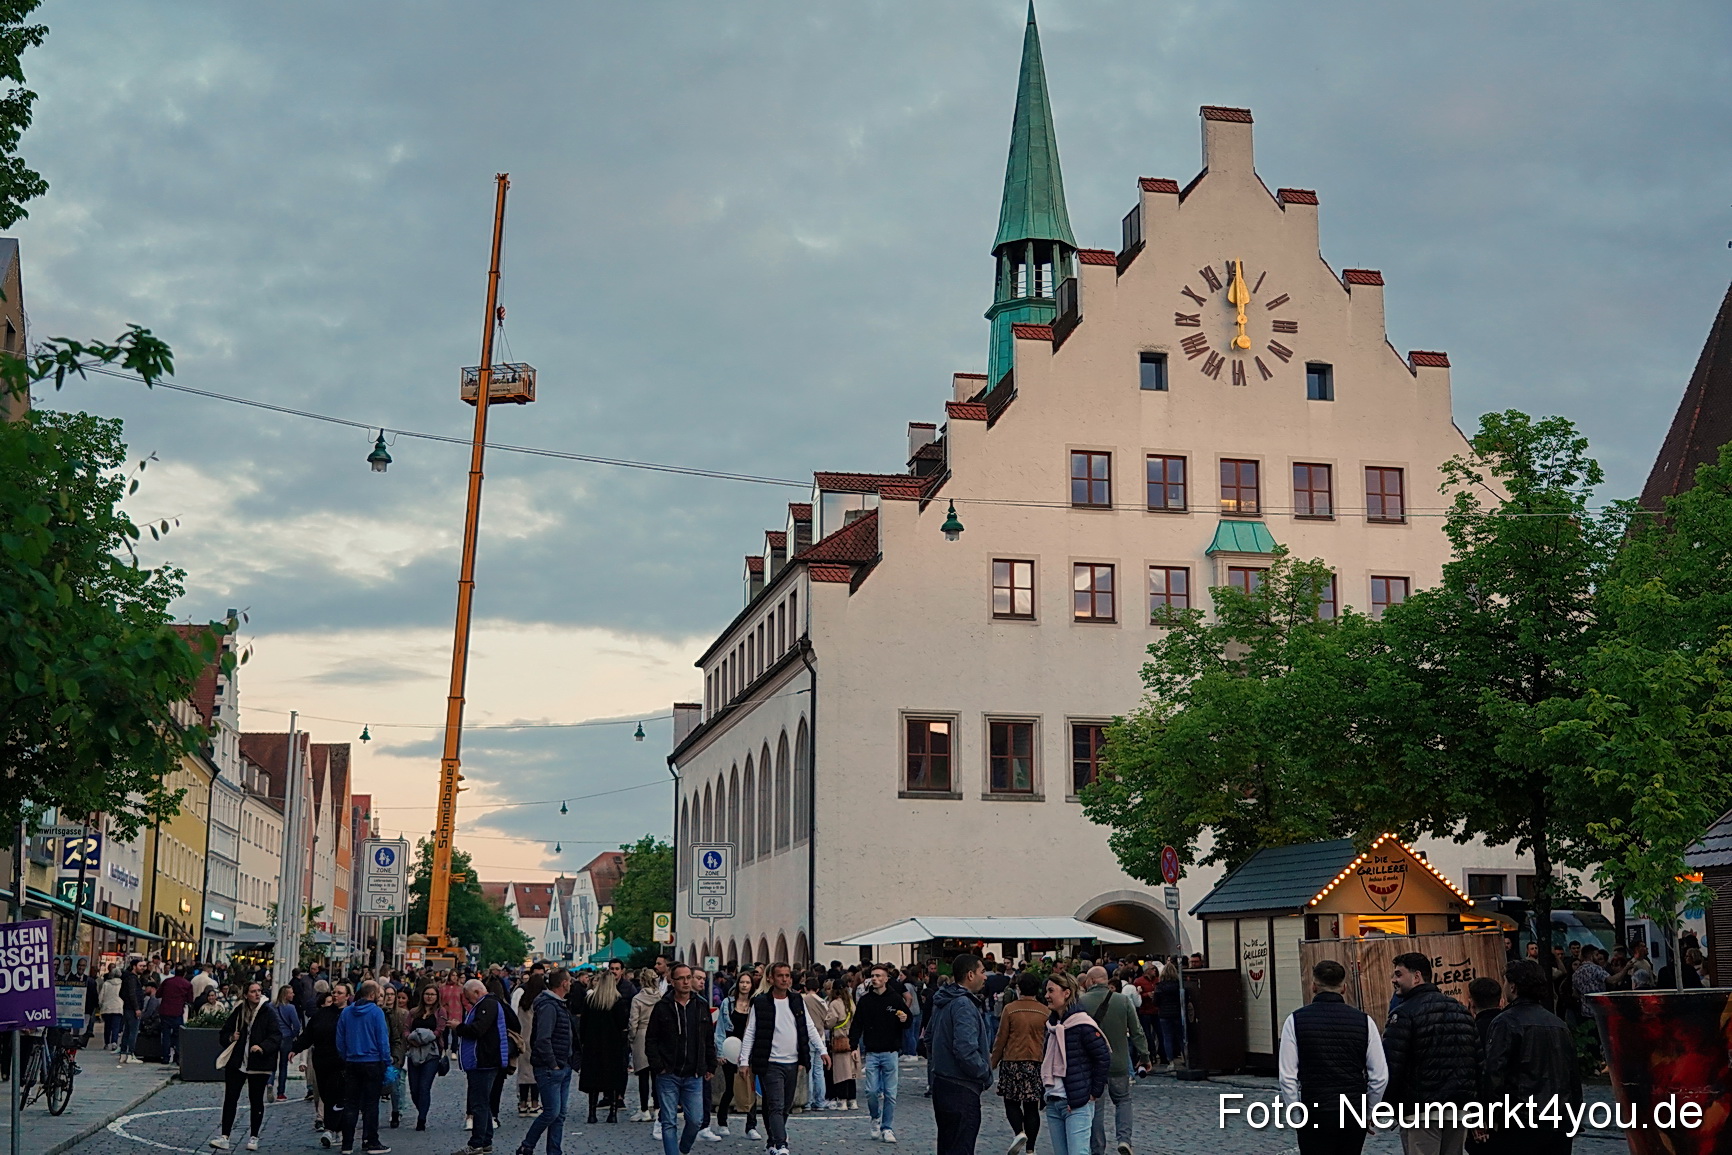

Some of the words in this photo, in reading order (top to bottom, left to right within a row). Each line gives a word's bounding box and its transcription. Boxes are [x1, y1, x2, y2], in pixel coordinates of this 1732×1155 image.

[438, 763, 454, 848] Schmidbauer
[39, 827, 82, 837] nwirtsgasse
[1357, 864, 1409, 876] GRILLEREI
[8, 926, 48, 946] KEIN
[0, 944, 48, 967] RSCH
[1430, 956, 1442, 968] IE
[0, 964, 50, 993] OCH
[1434, 968, 1476, 985] LEREI
[24, 1008, 52, 1021] Volt
